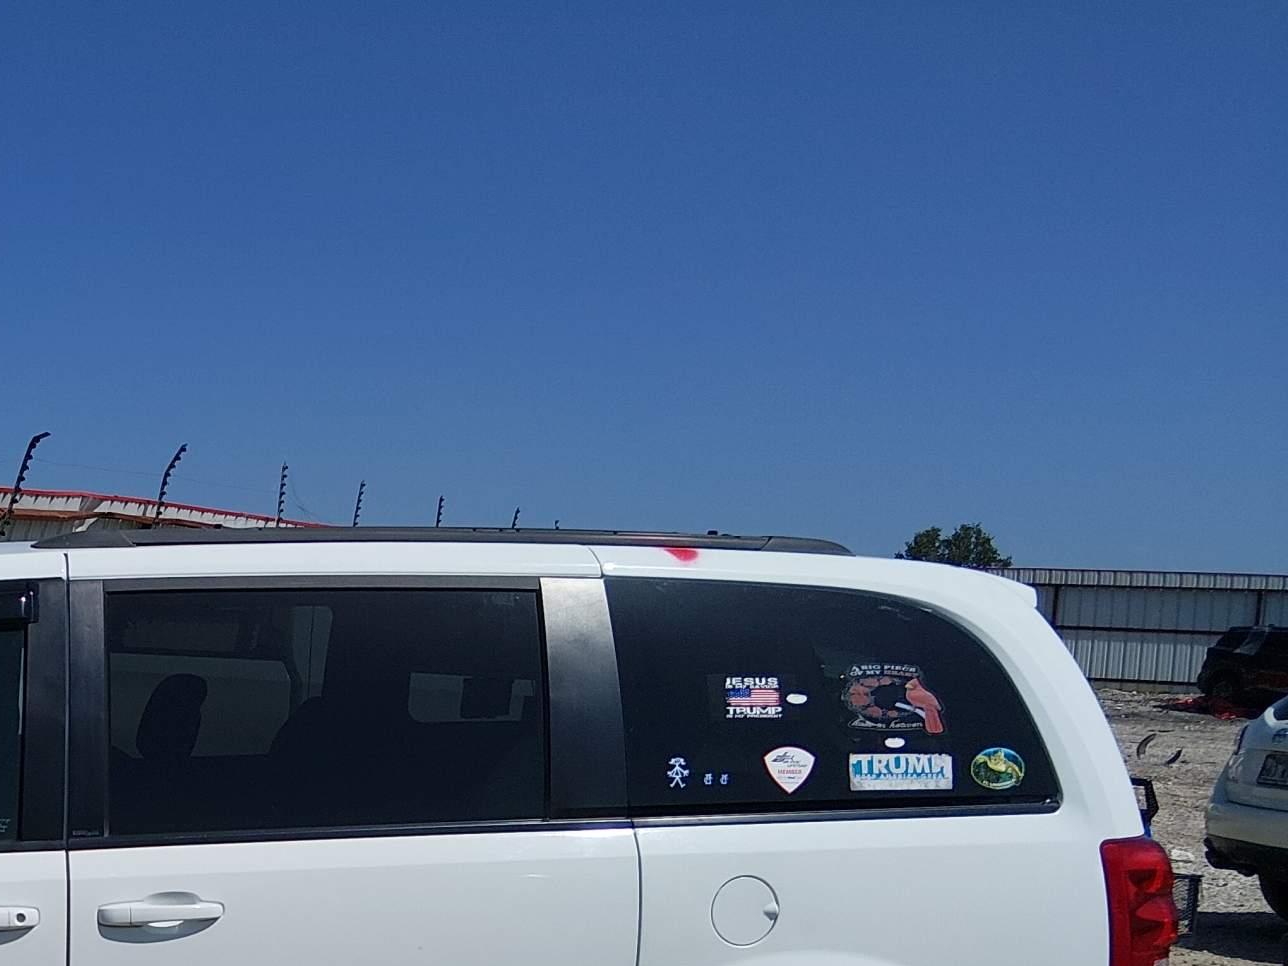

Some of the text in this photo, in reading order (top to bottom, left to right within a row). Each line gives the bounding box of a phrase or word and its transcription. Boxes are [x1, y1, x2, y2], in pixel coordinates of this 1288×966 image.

[851, 665, 860, 673] A
[883, 664, 917, 673] PIECE
[725, 677, 778, 686] JESUS
[726, 706, 782, 715] TRUMP
